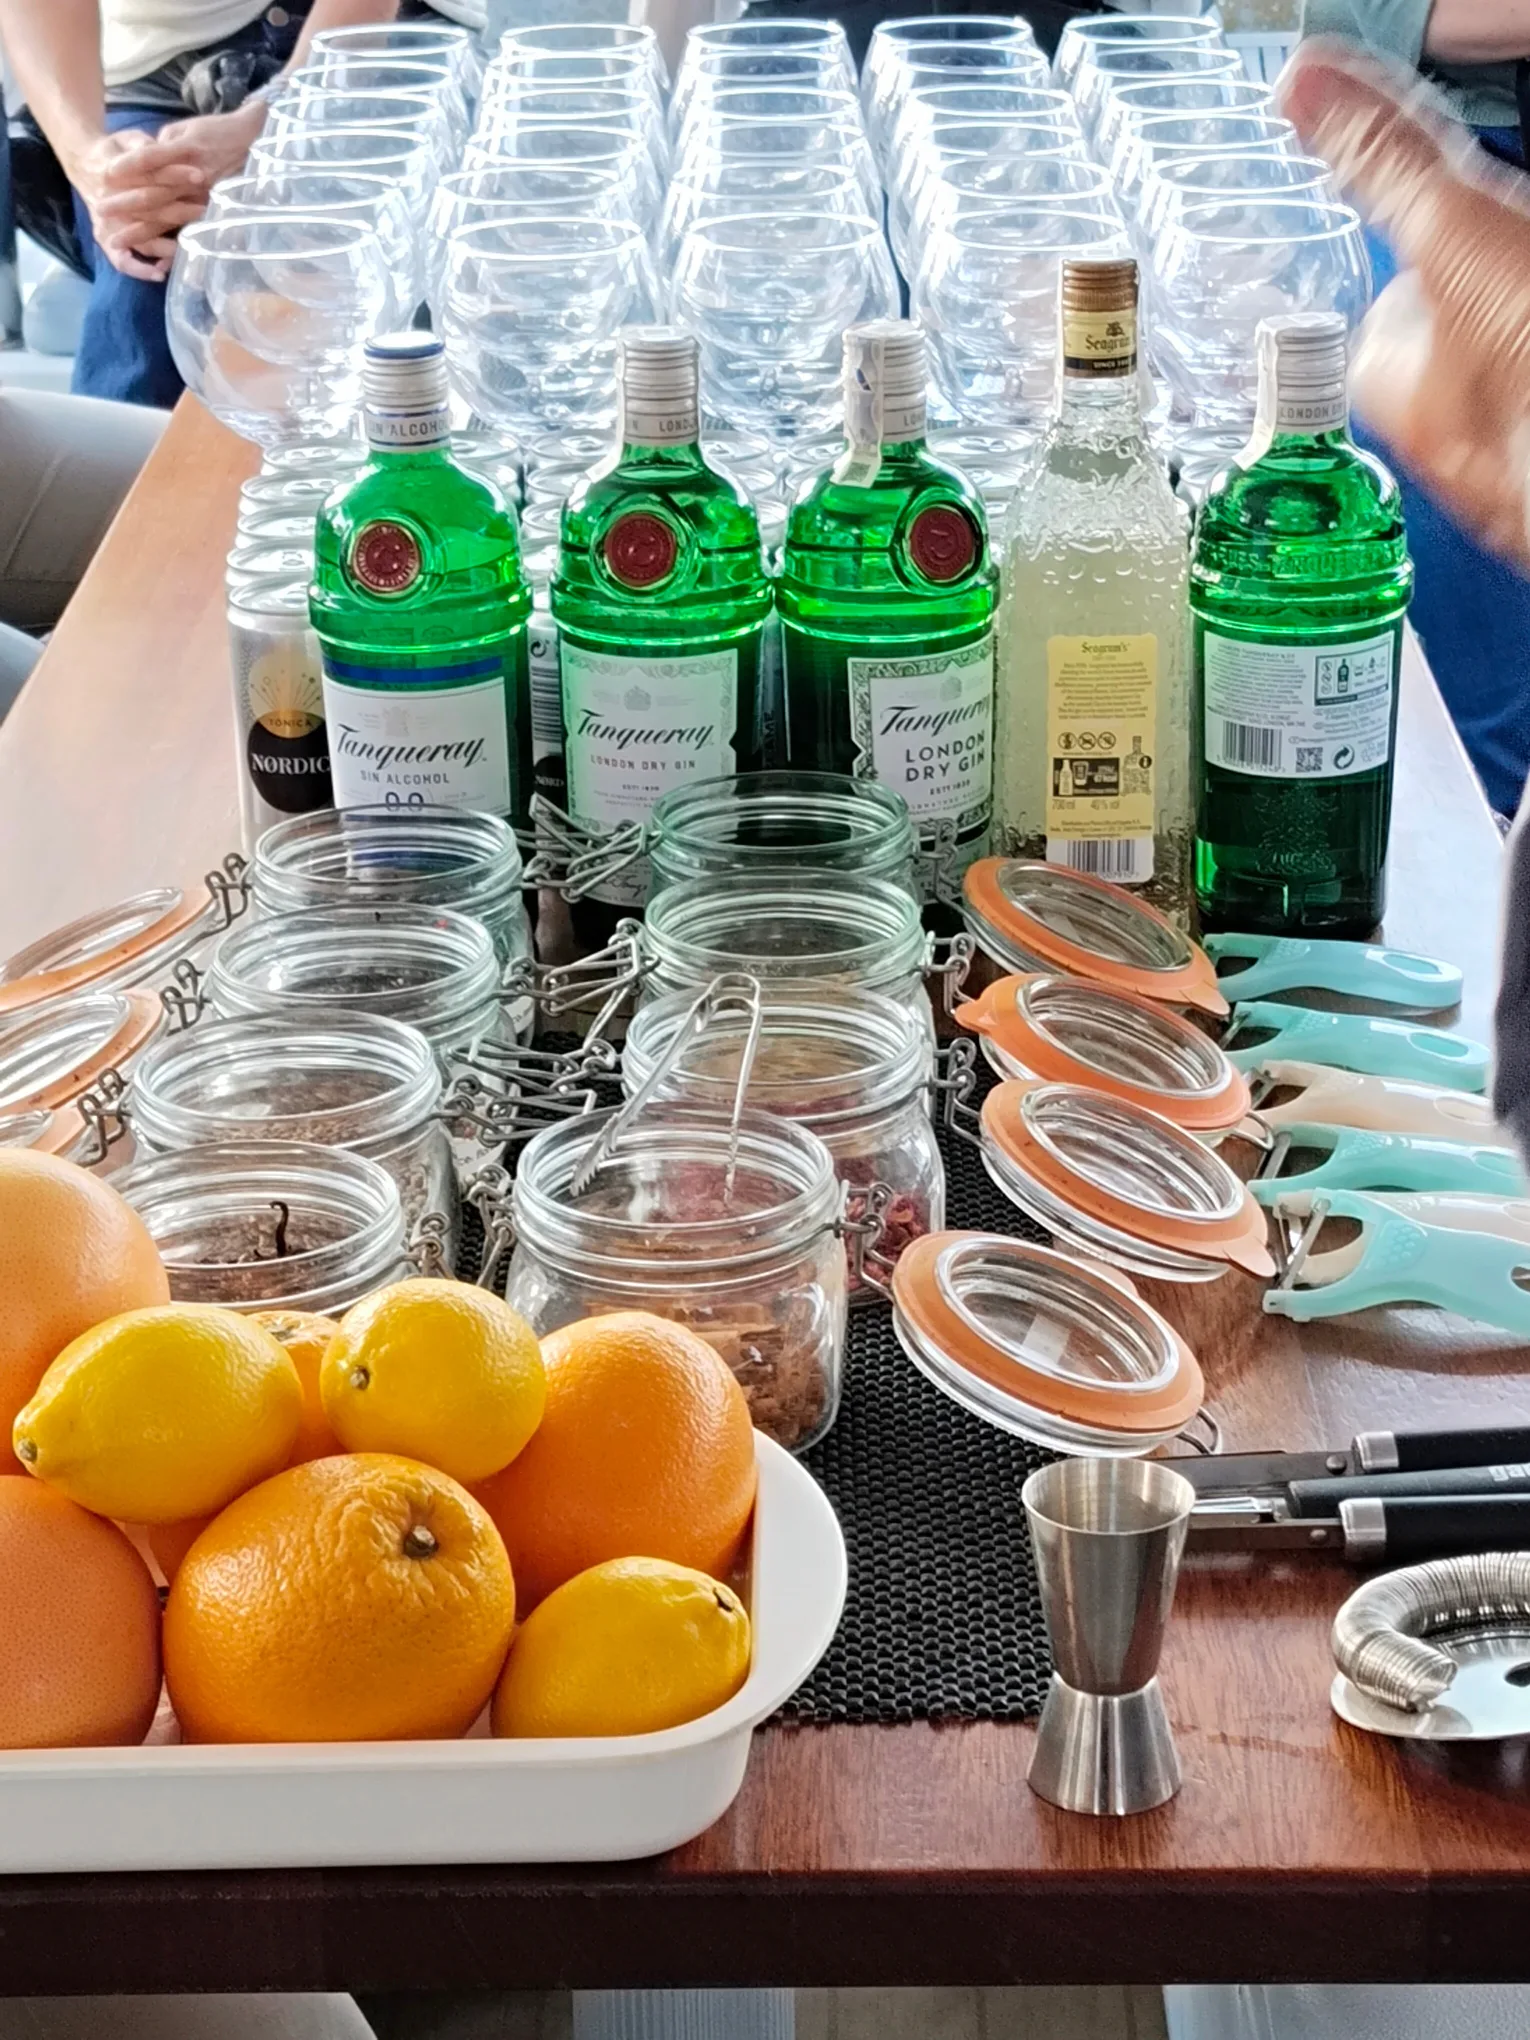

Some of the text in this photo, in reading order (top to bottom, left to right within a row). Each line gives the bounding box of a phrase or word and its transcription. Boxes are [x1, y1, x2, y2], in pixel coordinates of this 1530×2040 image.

[577, 708, 714, 750] Tanqueray
[338, 723, 486, 771] Tanqueray
[590, 754, 696, 771] LONDON DRY GIN
[906, 730, 985, 763] LONDON
[360, 769, 450, 785] SIN ALCOHOL
[905, 748, 985, 782] DRY GIN
